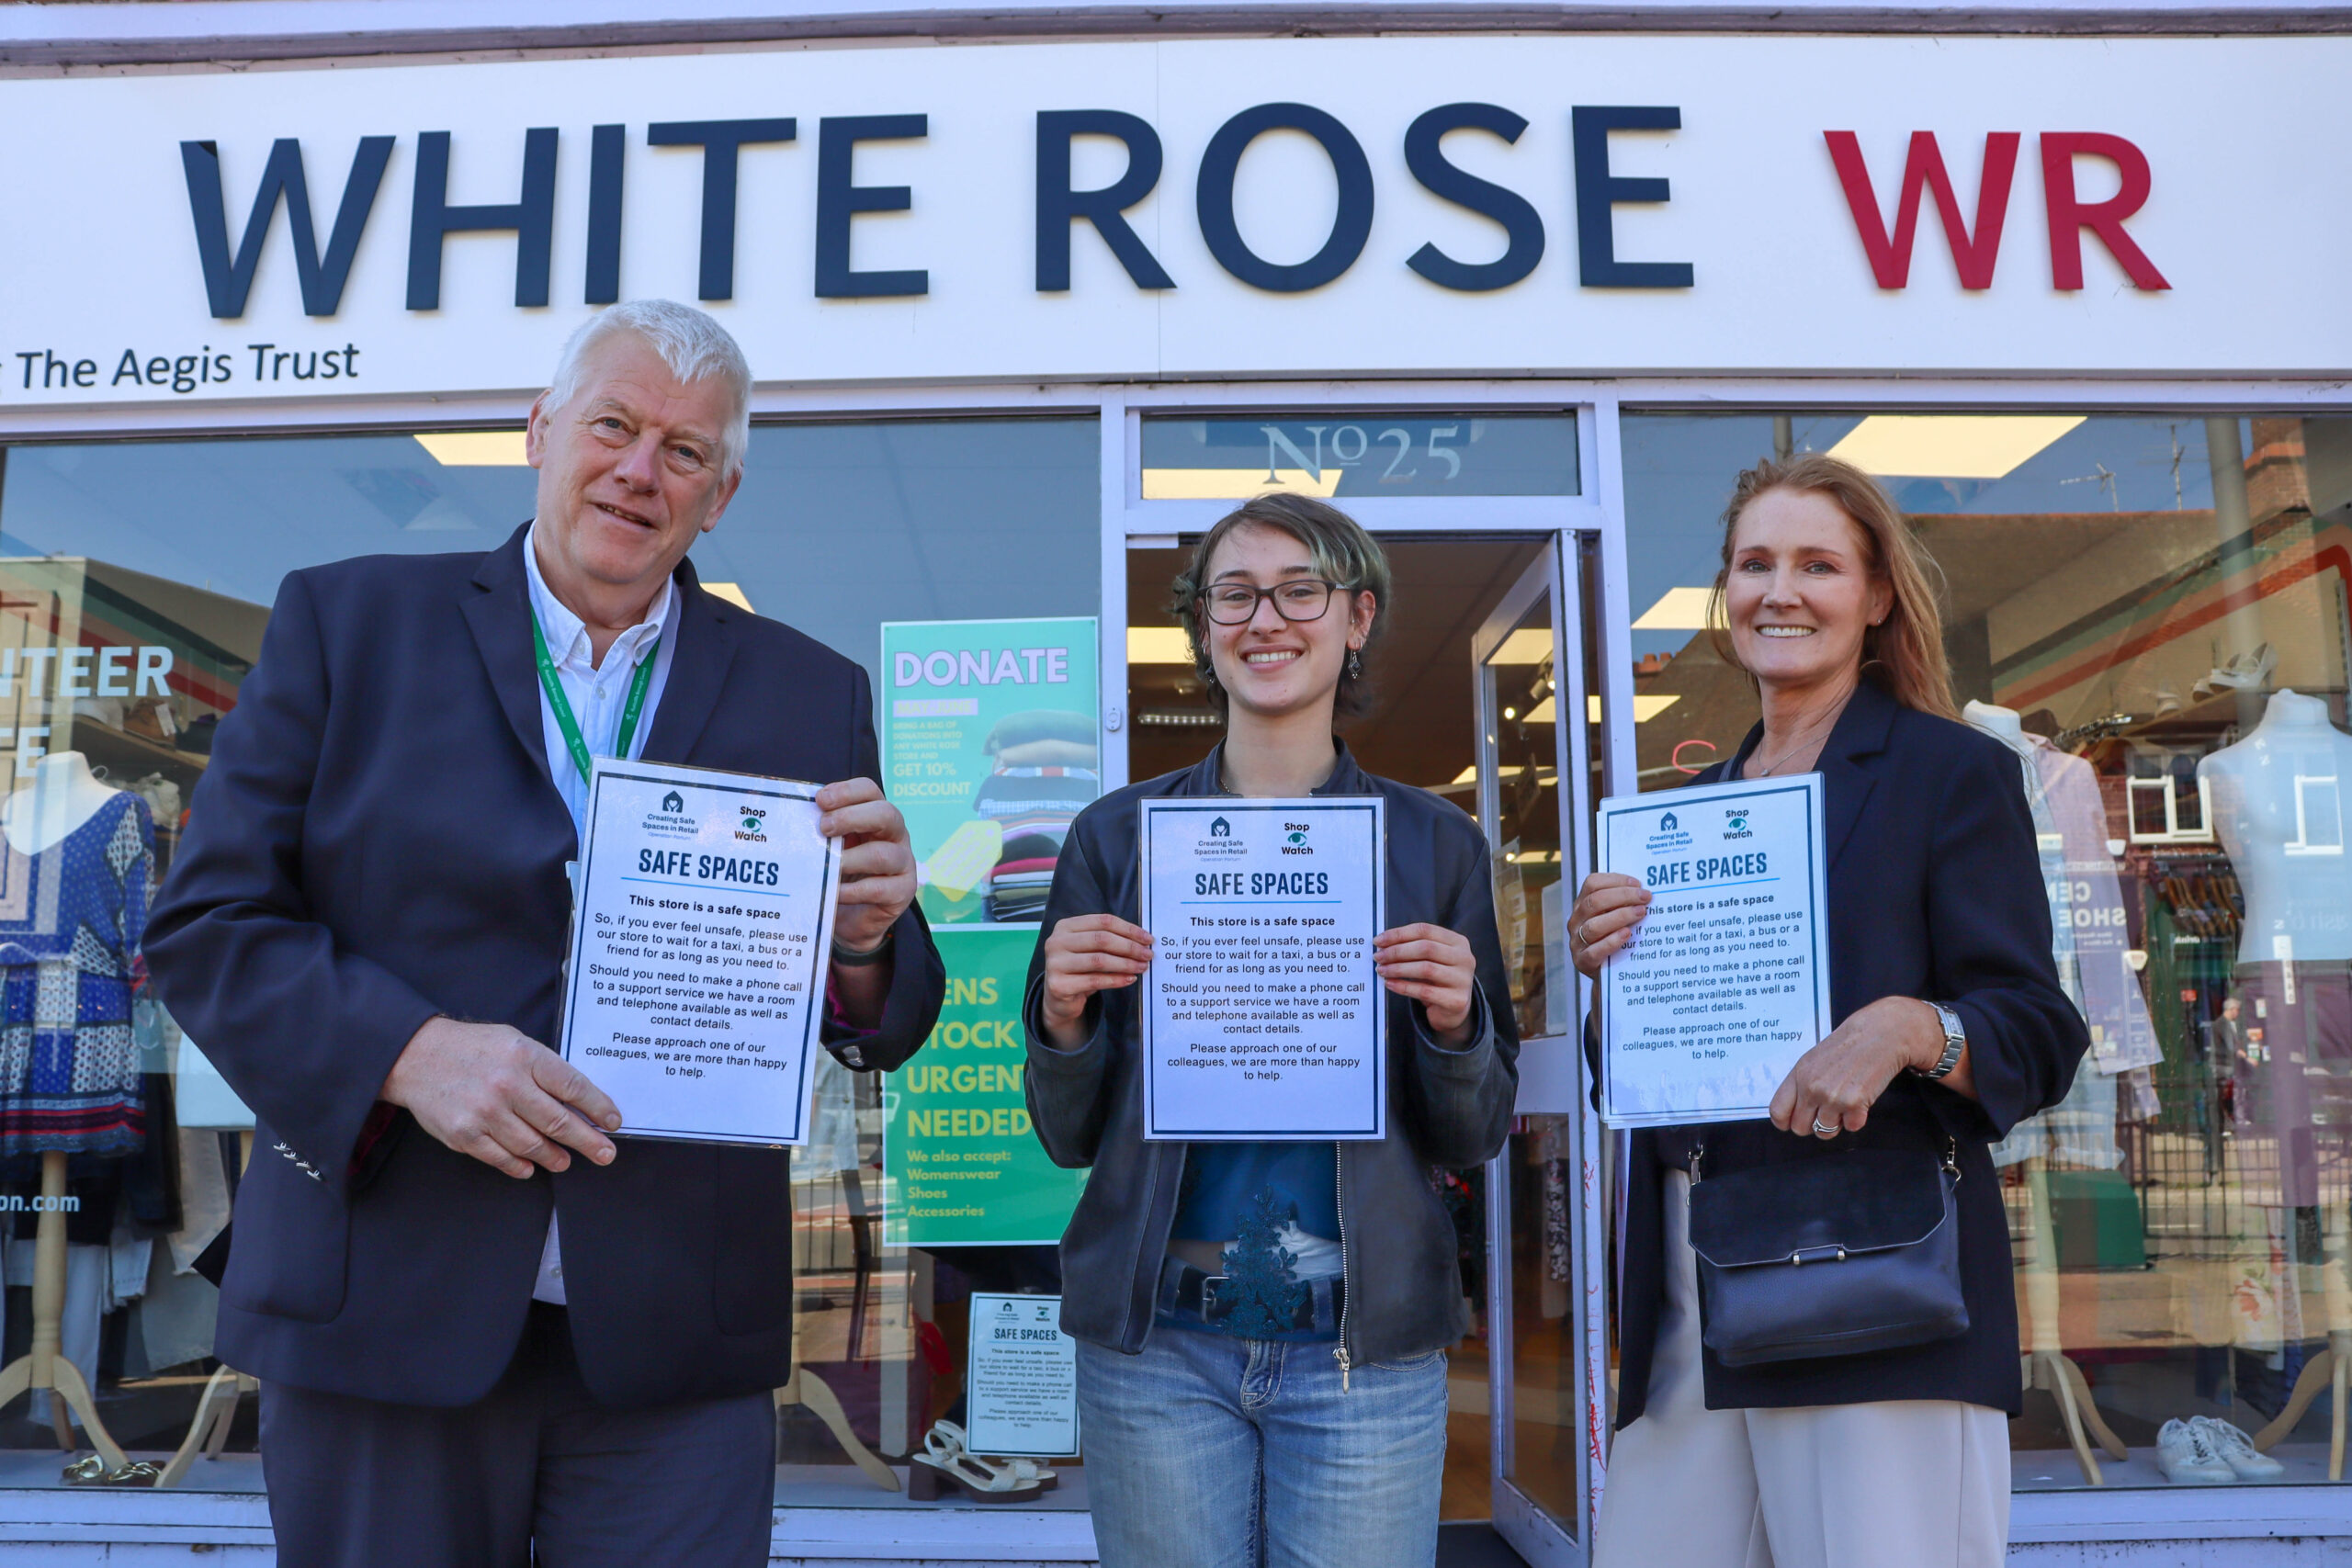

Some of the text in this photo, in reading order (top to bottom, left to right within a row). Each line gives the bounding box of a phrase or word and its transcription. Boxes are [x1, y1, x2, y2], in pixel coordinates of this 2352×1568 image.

[180, 102, 2172, 318] WHITE ROSE WR
[16, 344, 359, 393] The Aegis Trust
[894, 647, 1069, 688] DONATE
[894, 762, 956, 776] GET 10%
[894, 781, 971, 796] DISCOUNT
[647, 814, 678, 824] Creating
[740, 806, 766, 818] Shop
[1725, 809, 1748, 818] Shop
[642, 821, 669, 830] Spaces
[1284, 822, 1309, 832] Shop
[735, 830, 767, 842] Watch
[1649, 833, 1674, 841] Creating
[1724, 830, 1753, 840] Watch
[1282, 846, 1313, 854] Watch
[638, 848, 779, 886] SAFE SPACES
[1646, 852, 1767, 886] SAFE SPACES
[1194, 872, 1329, 896] SAFE SPACES
[628, 894, 781, 919] This store is a safe space
[1667, 903, 1694, 914] store
[1696, 900, 1706, 910] is
[1708, 901, 1714, 909] a
[1717, 897, 1740, 908] safe
[1742, 895, 1774, 908] space
[1190, 916, 1336, 929] This store is a safe space
[1160, 935, 1365, 949] So, if you ever feel unsafe, please use
[1164, 949, 1361, 963] our store to wait for a taxi, a bus or a
[1175, 962, 1351, 976] friend for as long as you need to.
[1161, 982, 1365, 996] Should you need to make a phone call
[1166, 996, 1360, 1010] to a support service we have a room
[1171, 1009, 1355, 1022] and telephone available as well as
[930, 1021, 1018, 1049] TOCK
[1223, 1021, 1303, 1035] contact details.
[1190, 1043, 1338, 1056] Please approach one of our
[1167, 1055, 1361, 1069] colleagues, we are more than happy
[1243, 1069, 1283, 1082] to help.
[908, 1109, 1032, 1137] NEEDED
[907, 1149, 1012, 1164] We also accept:
[907, 1168, 1001, 1179] Womenswear
[908, 1186, 947, 1199] Shoes
[907, 1204, 985, 1216] Accessories
[994, 1328, 1057, 1341] SAFE SPACES
